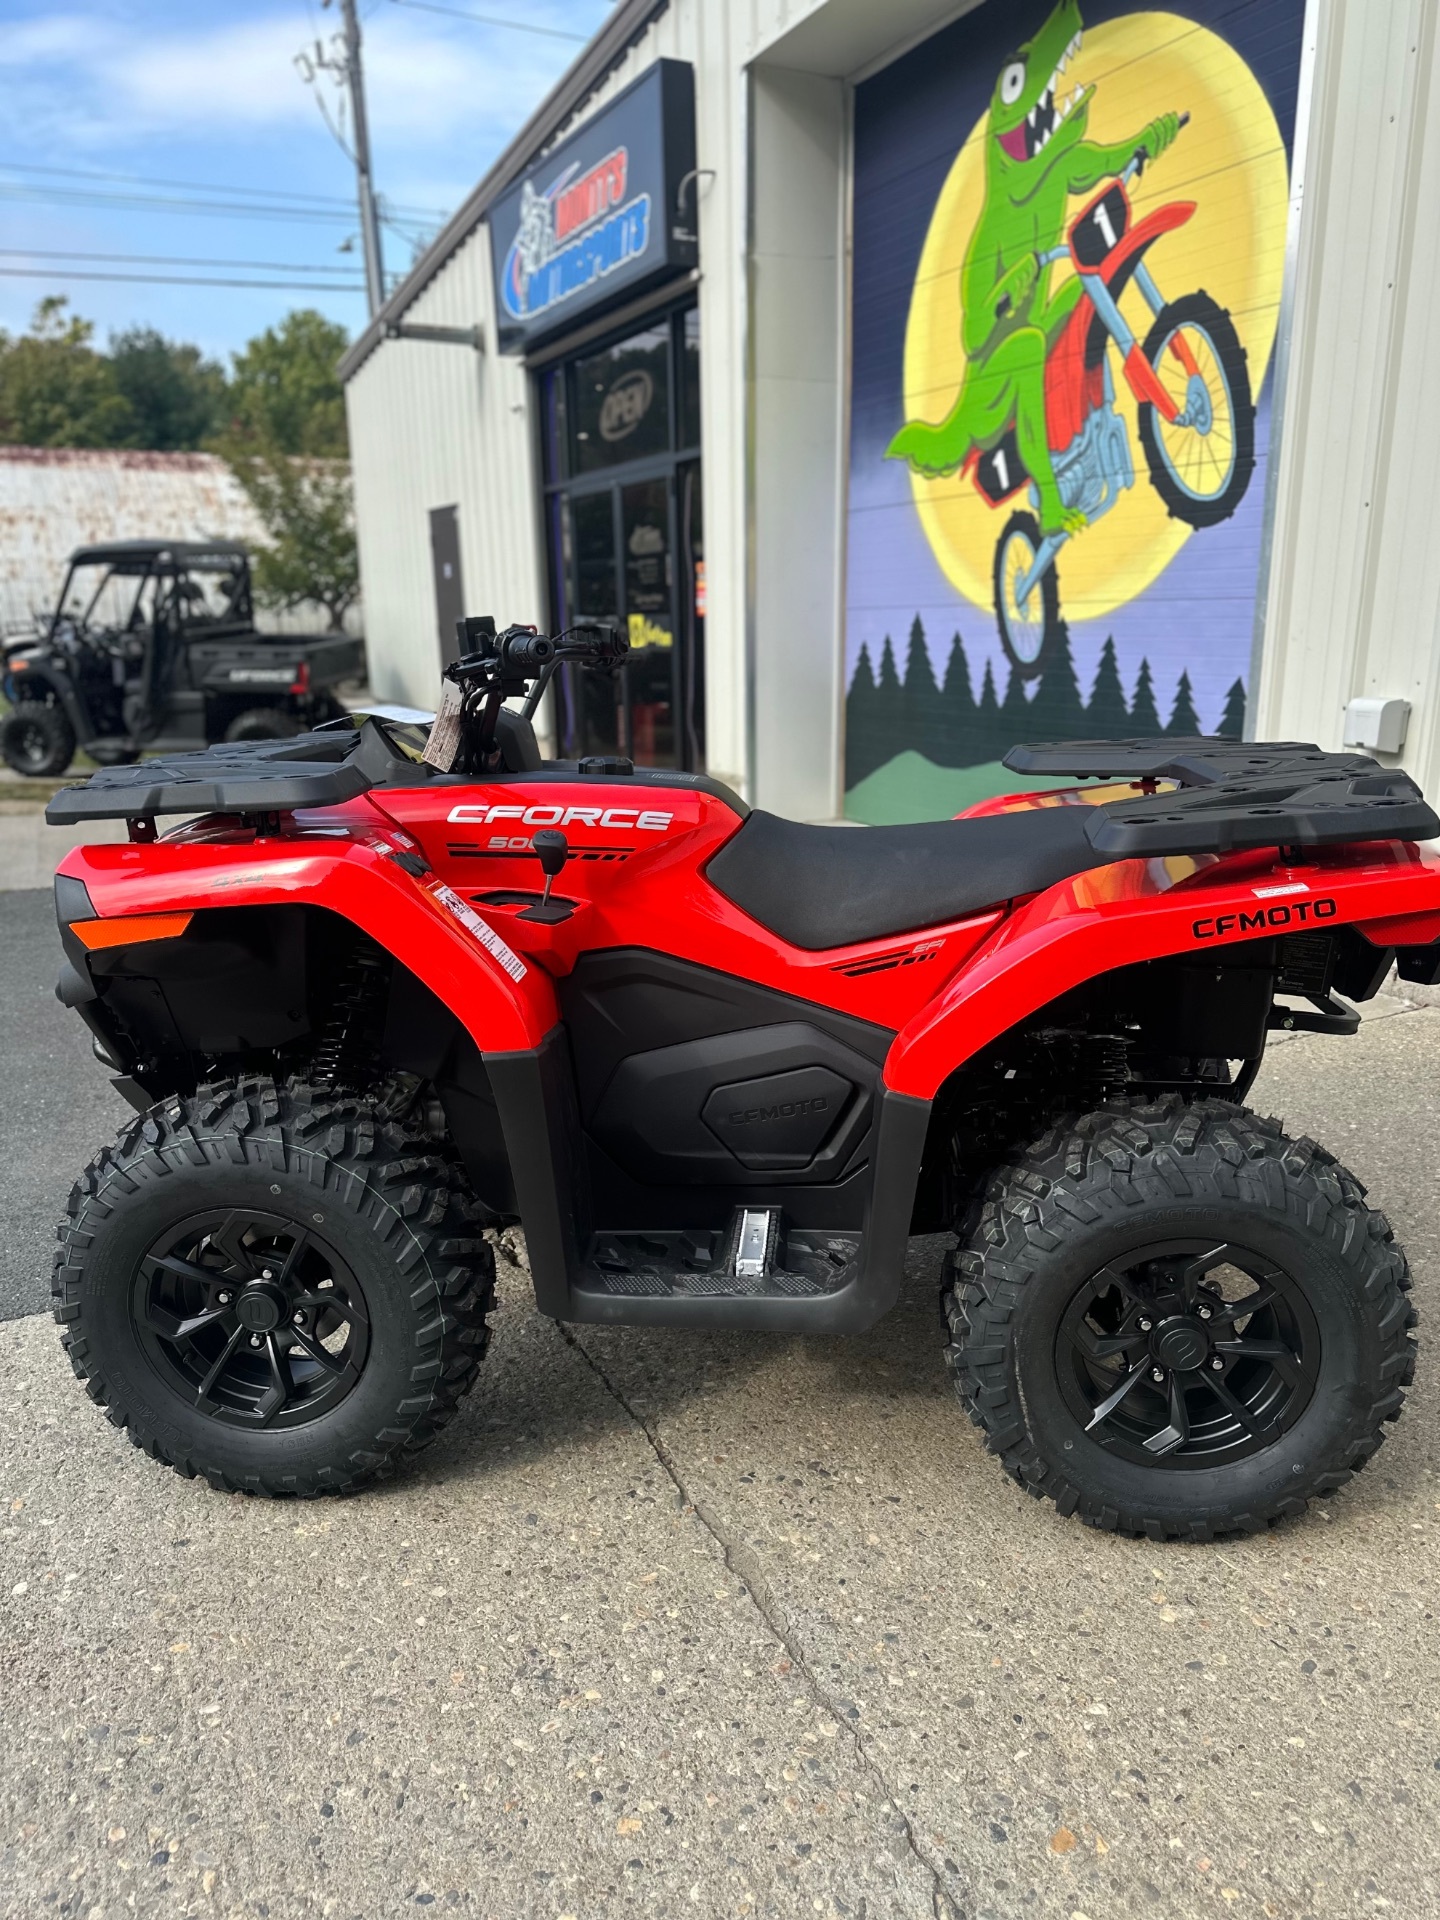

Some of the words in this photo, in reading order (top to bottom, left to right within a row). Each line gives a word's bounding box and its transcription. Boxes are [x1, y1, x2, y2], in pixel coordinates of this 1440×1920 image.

[1094, 203, 1117, 248] 1
[994, 450, 1009, 490] 1
[446, 804, 674, 831] CFORCE
[487, 836, 534, 849] 50
[1192, 898, 1337, 939] CFMOTO
[728, 1098, 829, 1127] CFMOTO
